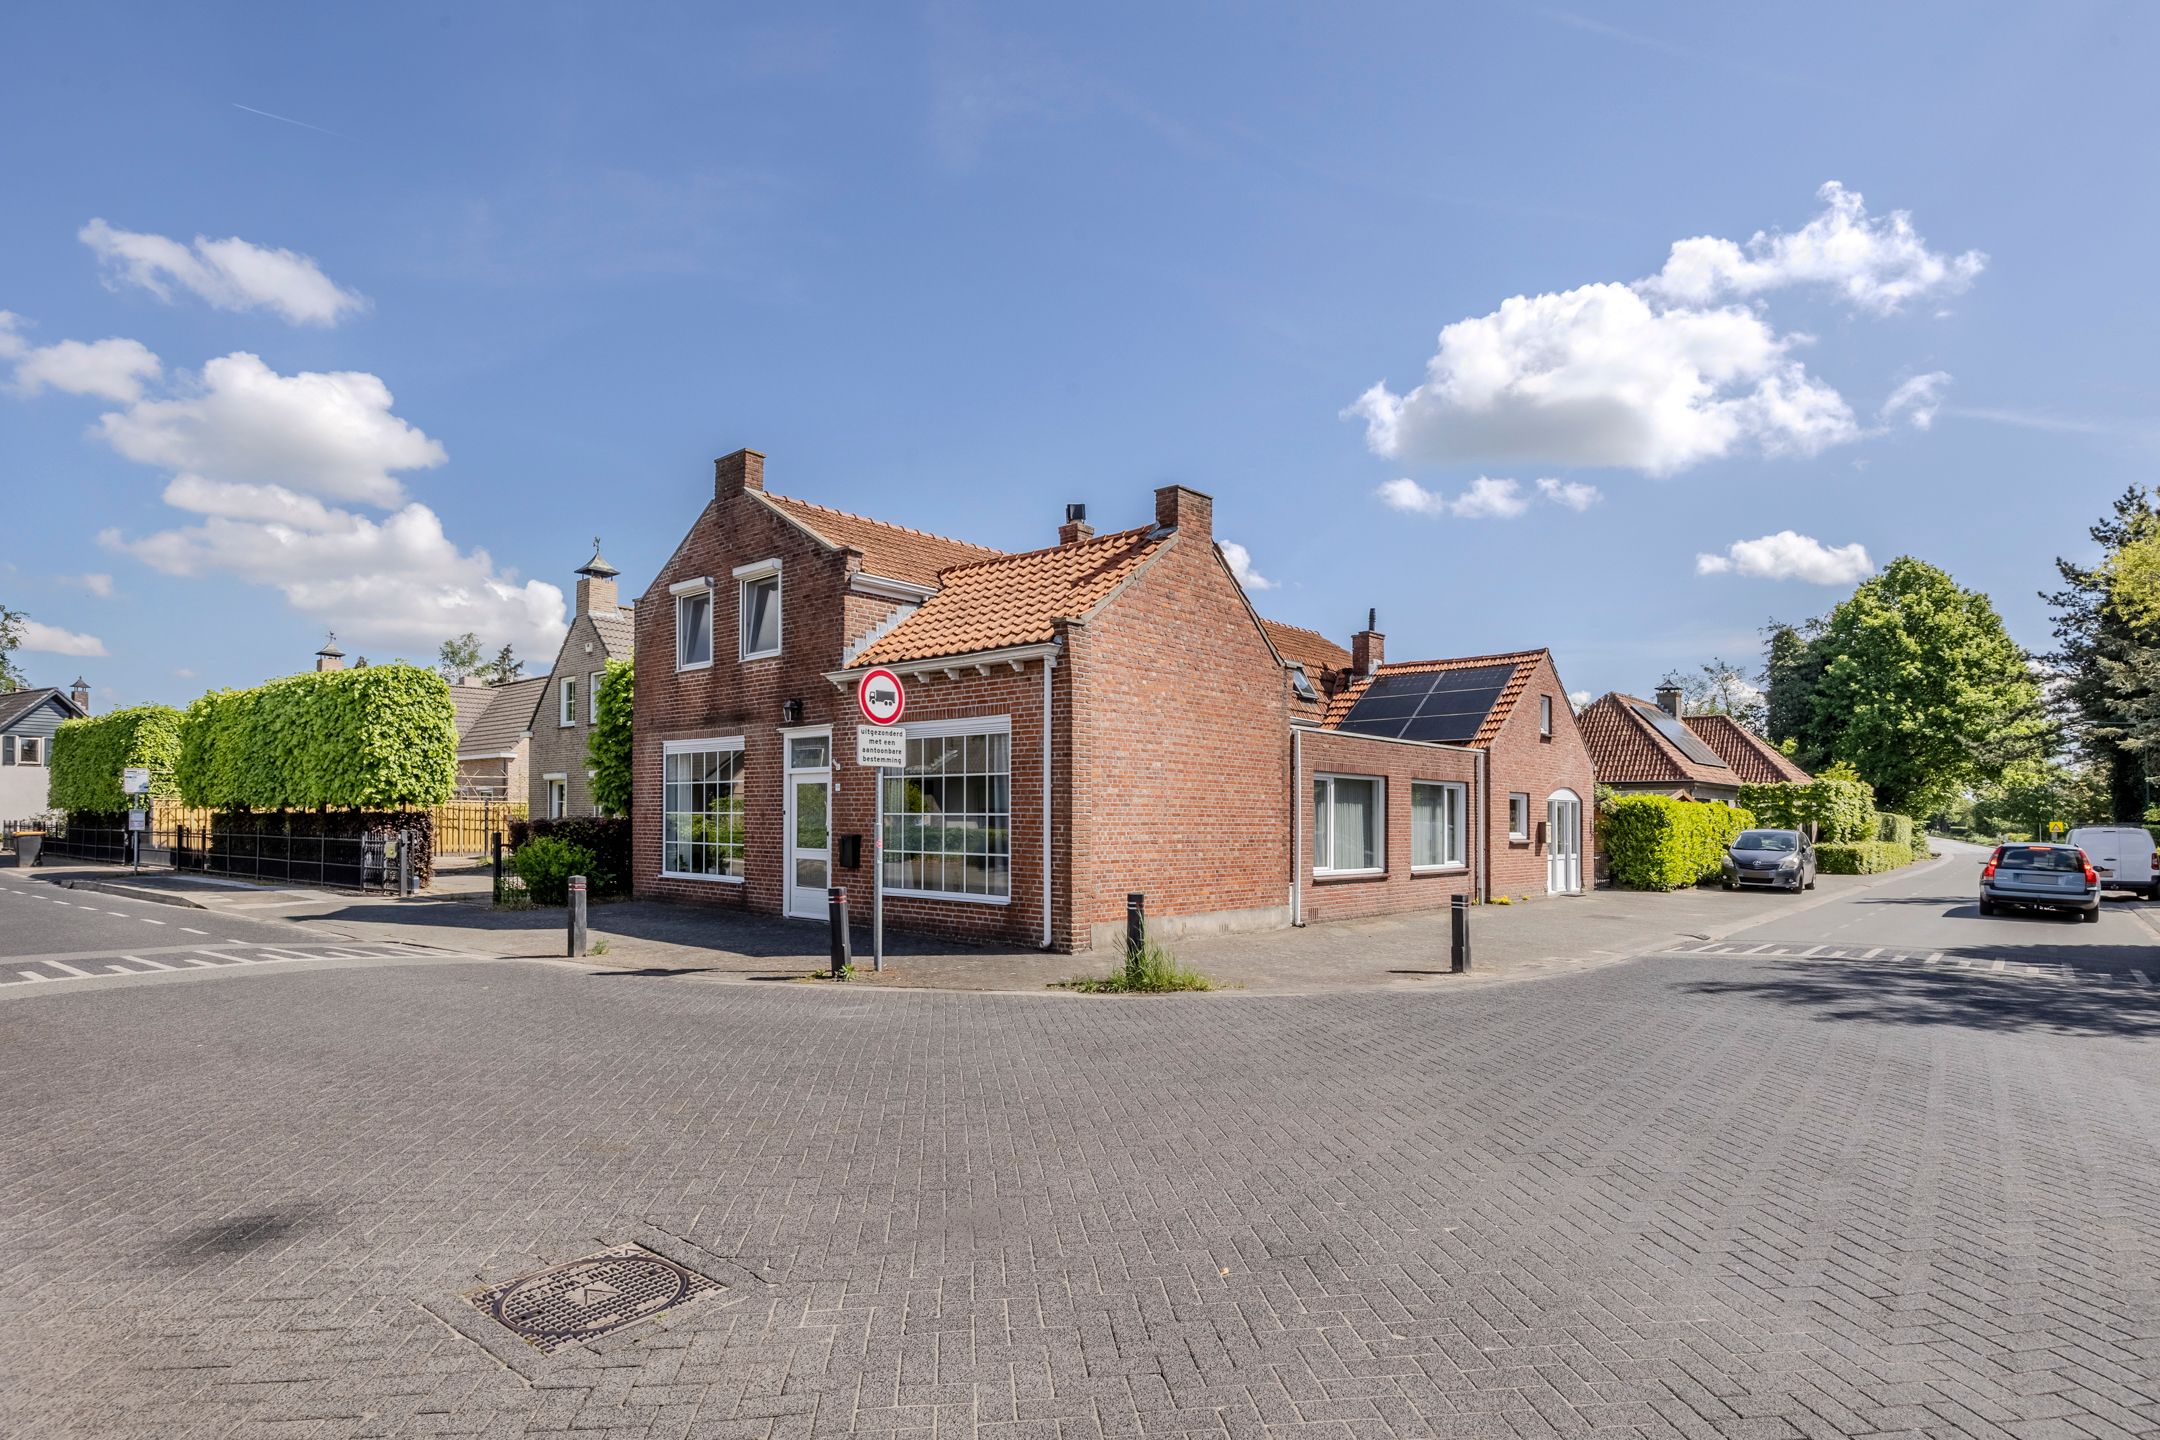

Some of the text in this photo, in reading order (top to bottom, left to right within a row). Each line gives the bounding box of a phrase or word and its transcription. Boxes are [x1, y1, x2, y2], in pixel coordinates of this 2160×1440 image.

[860, 728, 903, 737] uitgezonderd
[862, 747, 902, 755] aantoonbare
[862, 756, 902, 765] bestemming
